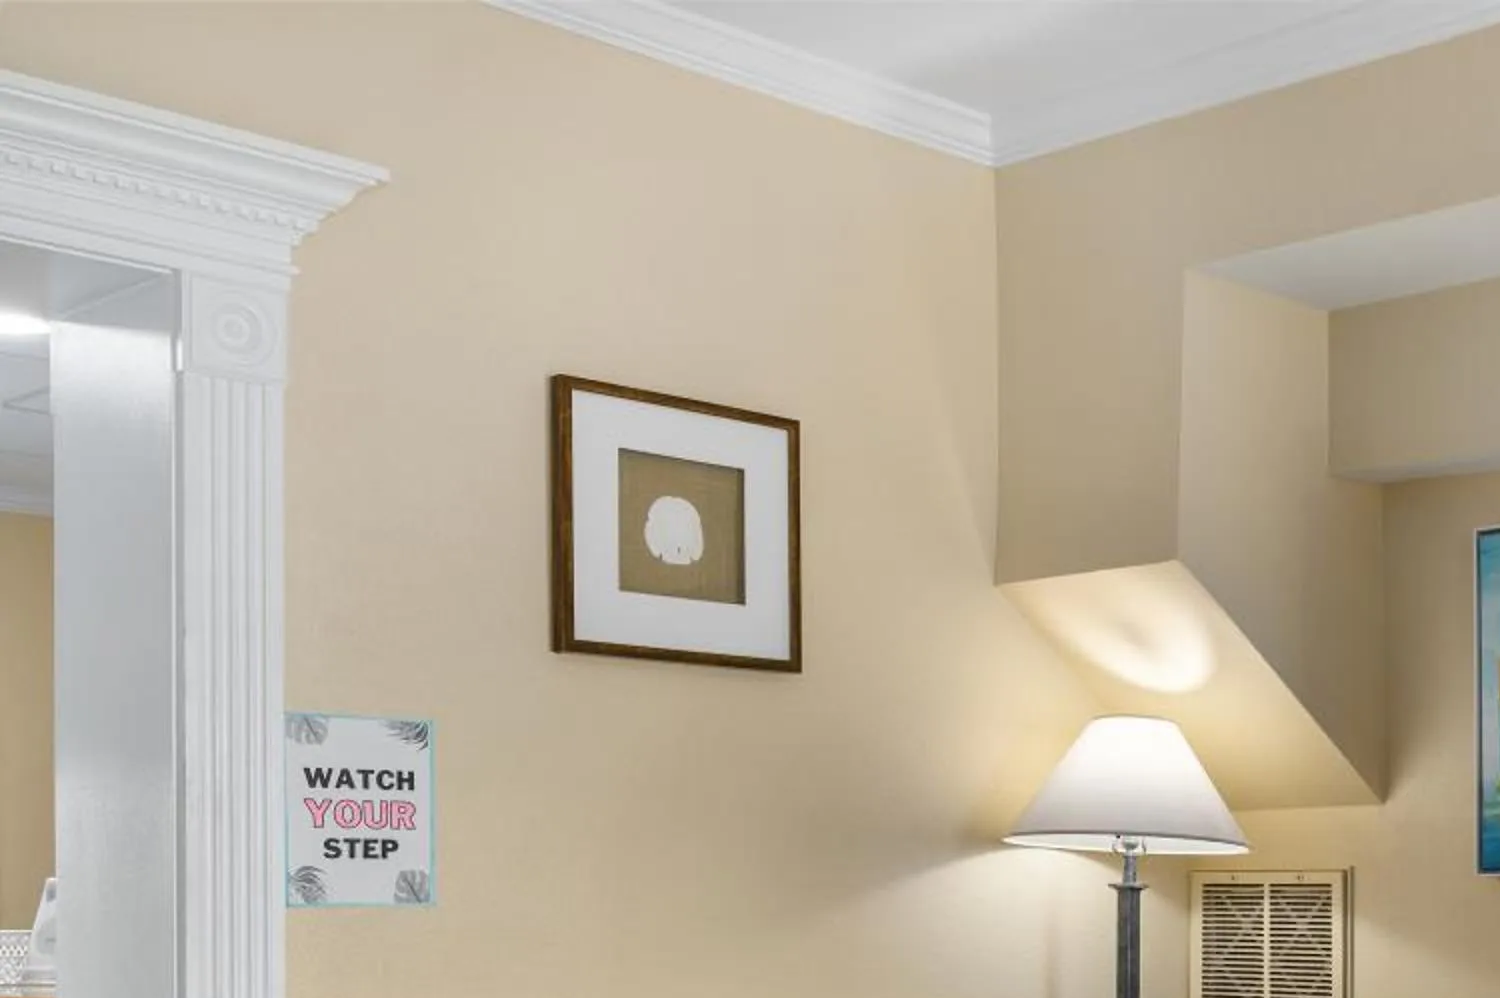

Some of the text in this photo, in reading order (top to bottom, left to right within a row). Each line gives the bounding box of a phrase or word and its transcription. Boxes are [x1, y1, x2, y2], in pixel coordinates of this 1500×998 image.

[303, 767, 415, 791] WATCH
[303, 798, 417, 830] YOUR
[323, 837, 399, 859] STEP
